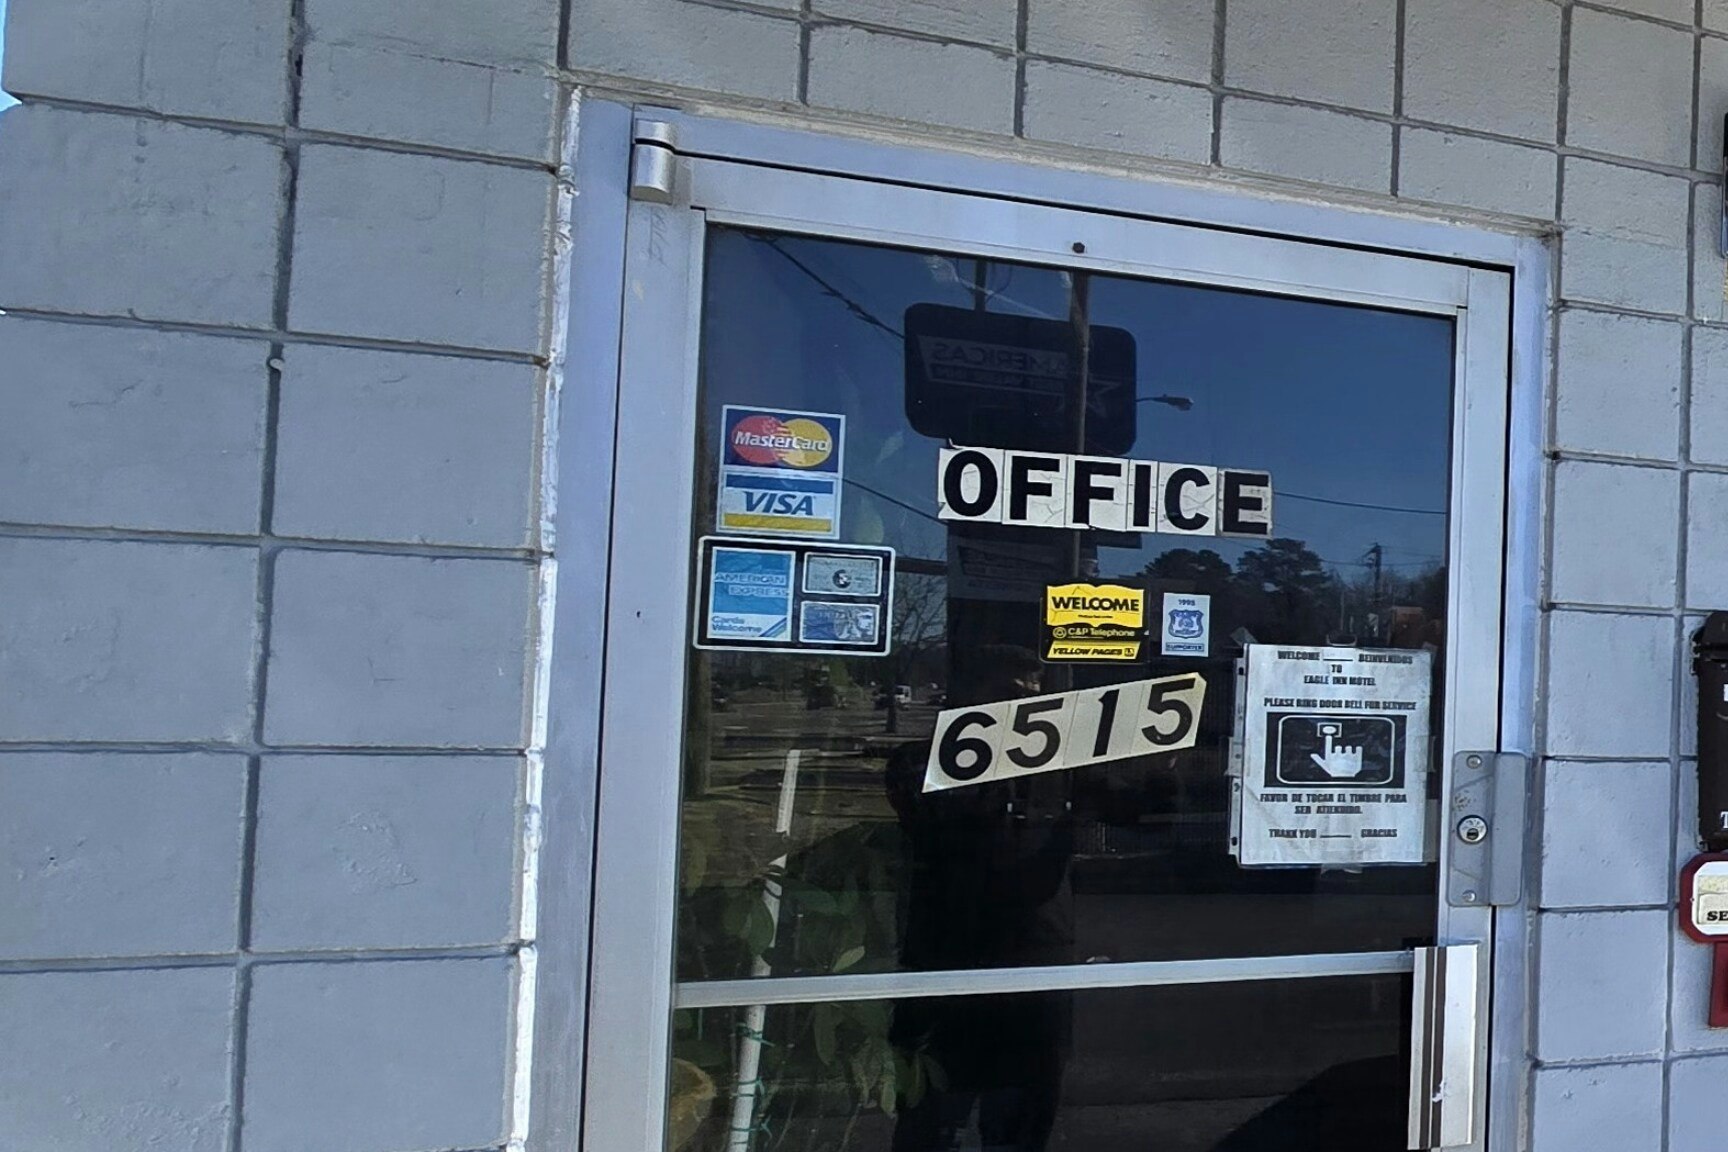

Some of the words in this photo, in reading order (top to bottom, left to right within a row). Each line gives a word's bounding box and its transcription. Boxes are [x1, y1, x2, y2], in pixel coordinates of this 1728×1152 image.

[734, 430, 830, 452] MasterCard
[943, 450, 1270, 536] OFFICE
[743, 491, 815, 516] VISA
[714, 572, 787, 585] AMERICAN
[729, 585, 790, 598] EXPRESS
[1052, 596, 1140, 612] WELCOME
[711, 614, 746, 626] Cards
[711, 622, 763, 634] Welcome
[1068, 627, 1089, 636] C&P
[1090, 628, 1136, 638] Telephone
[1053, 647, 1092, 655] YELLOW
[1092, 648, 1123, 656] PAGES
[1277, 650, 1321, 661] WELCOME
[1331, 664, 1343, 673] TO
[1304, 675, 1329, 686] EAGLE
[1332, 676, 1348, 686] INN
[1349, 676, 1377, 687] MOTEL
[1263, 697, 1295, 708] PLEASE
[1319, 698, 1343, 709] DOOR
[1344, 699, 1363, 709] BELL
[1364, 700, 1381, 710] FOR
[1382, 700, 1417, 711] SERVICE
[938, 677, 1197, 782] 6515
[1268, 828, 1298, 839] THANK
[1298, 829, 1317, 838] YOU
[1360, 828, 1398, 838] GRACIAS
